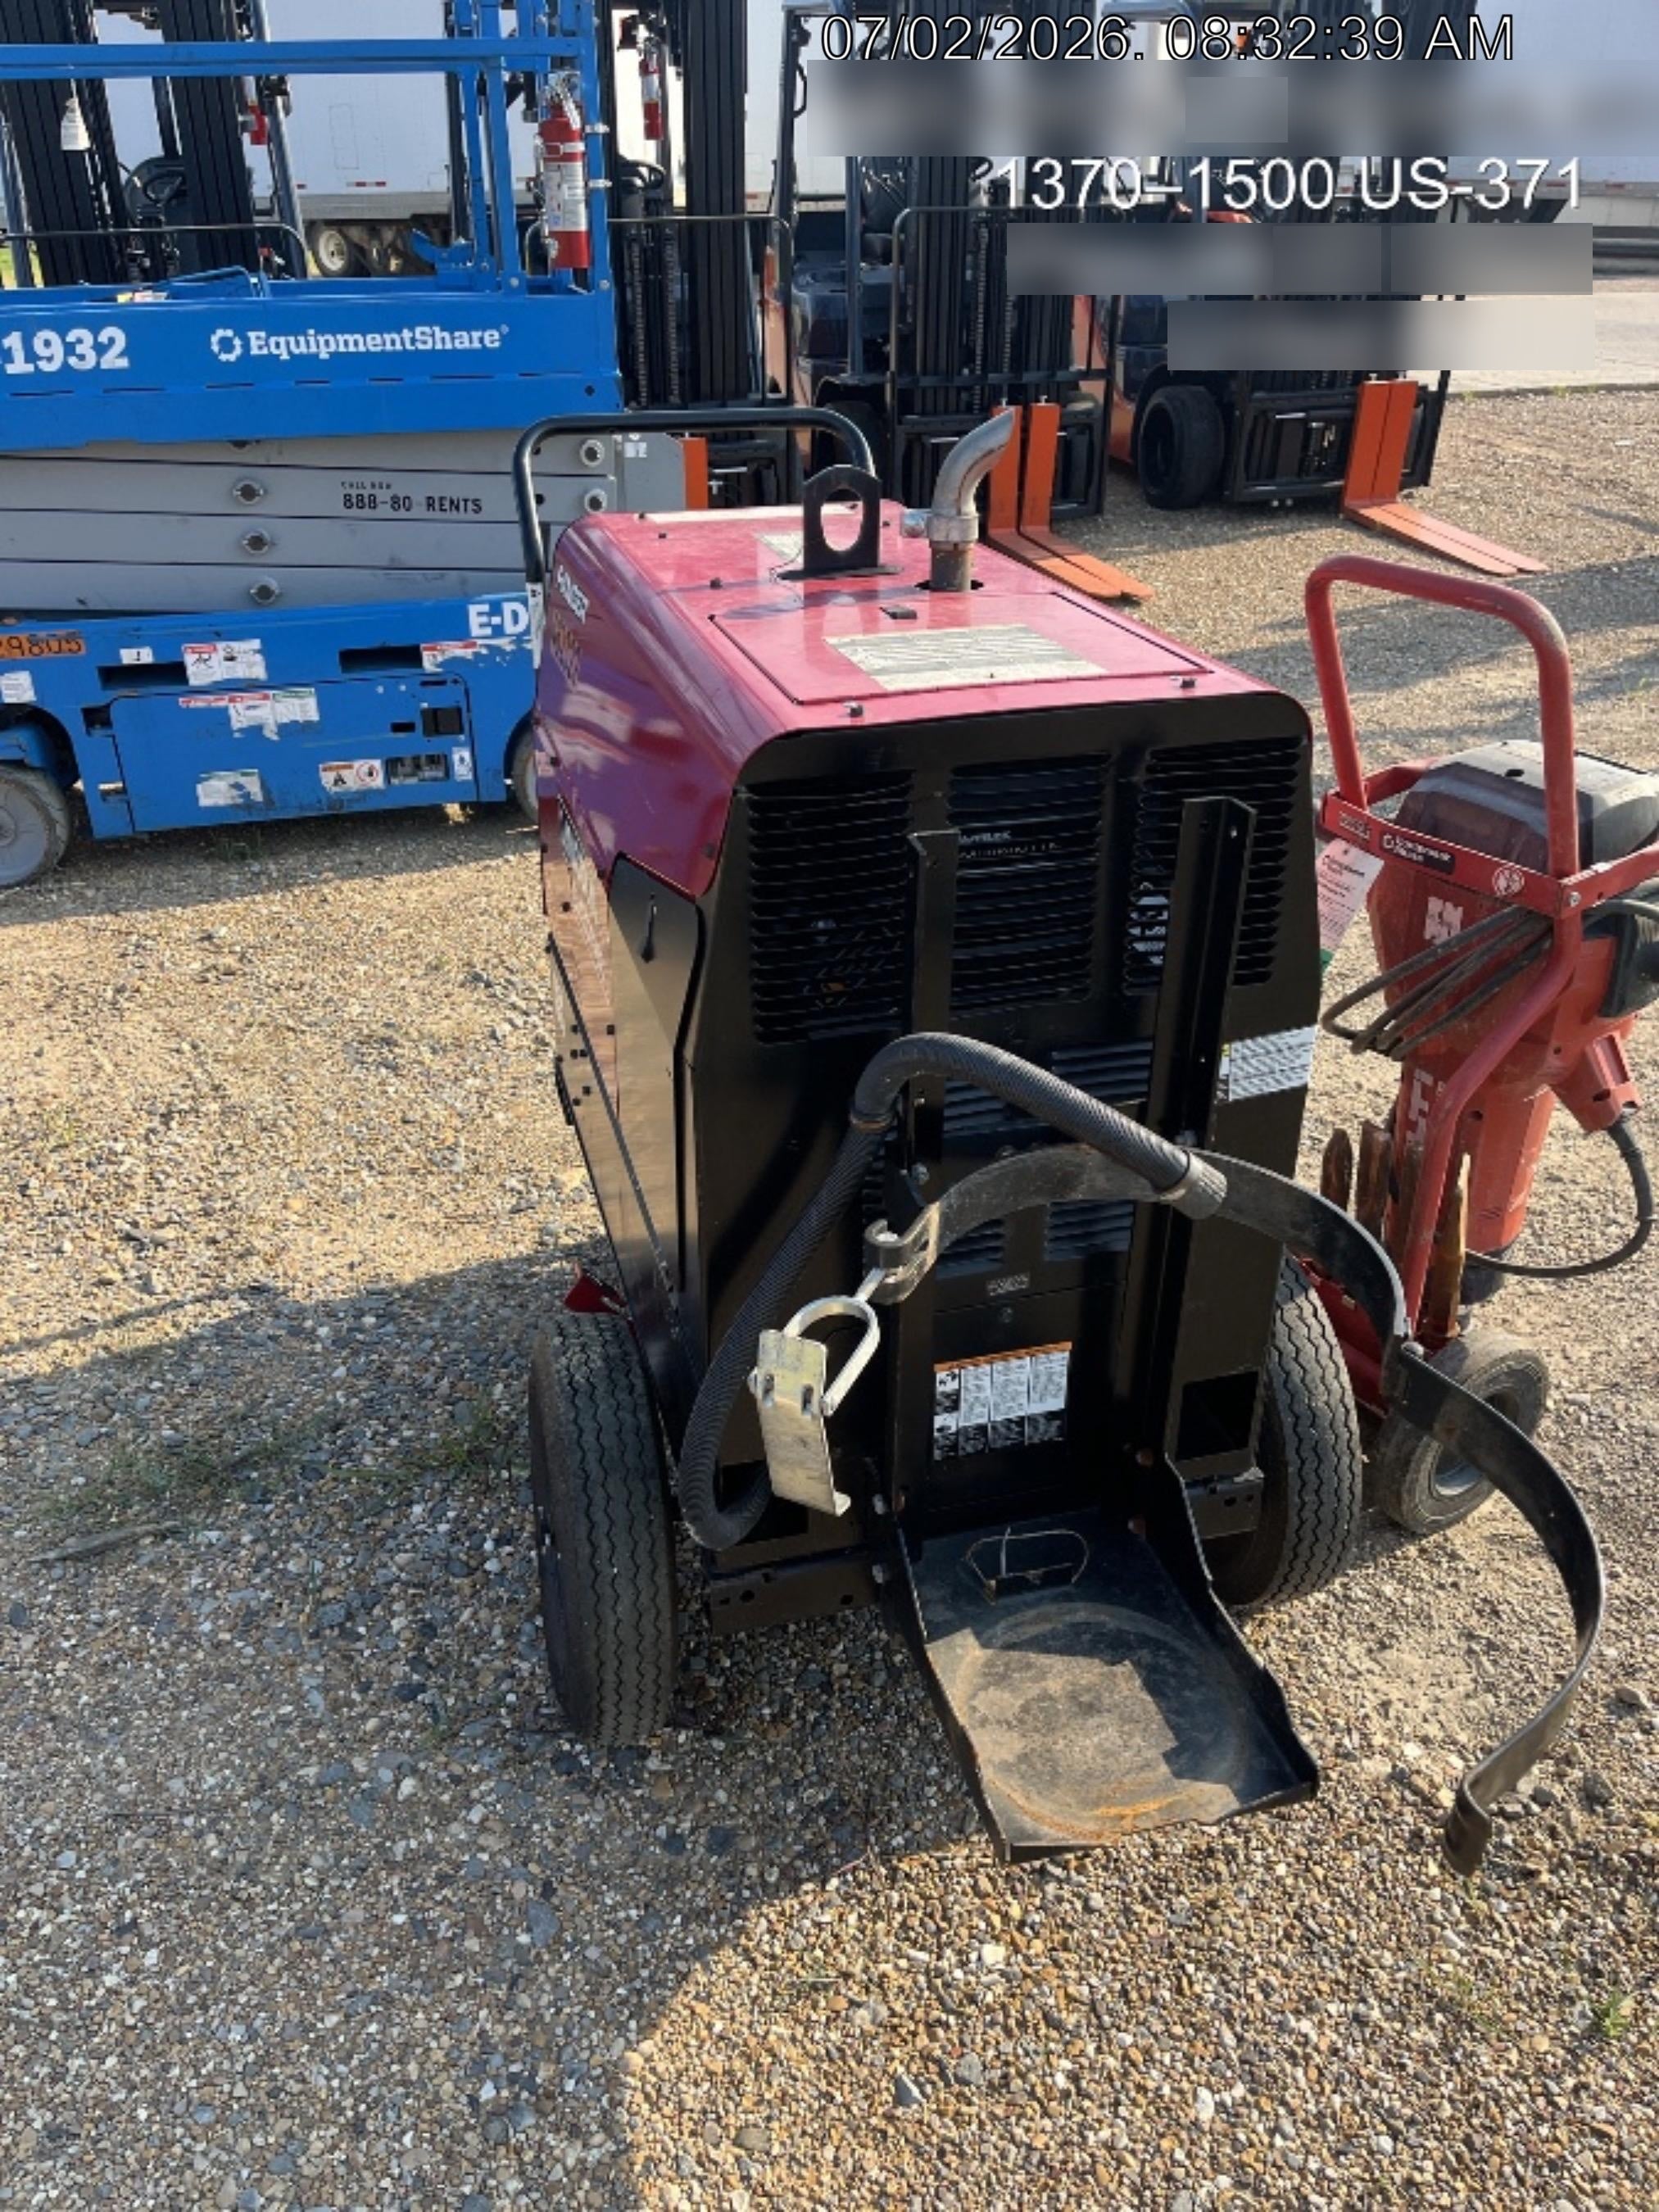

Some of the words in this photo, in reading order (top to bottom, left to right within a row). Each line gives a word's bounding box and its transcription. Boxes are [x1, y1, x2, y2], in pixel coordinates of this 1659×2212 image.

[0, 326, 129, 374] 1932
[468, 601, 530, 637] E-D
[0, 636, 82, 657] 9805
